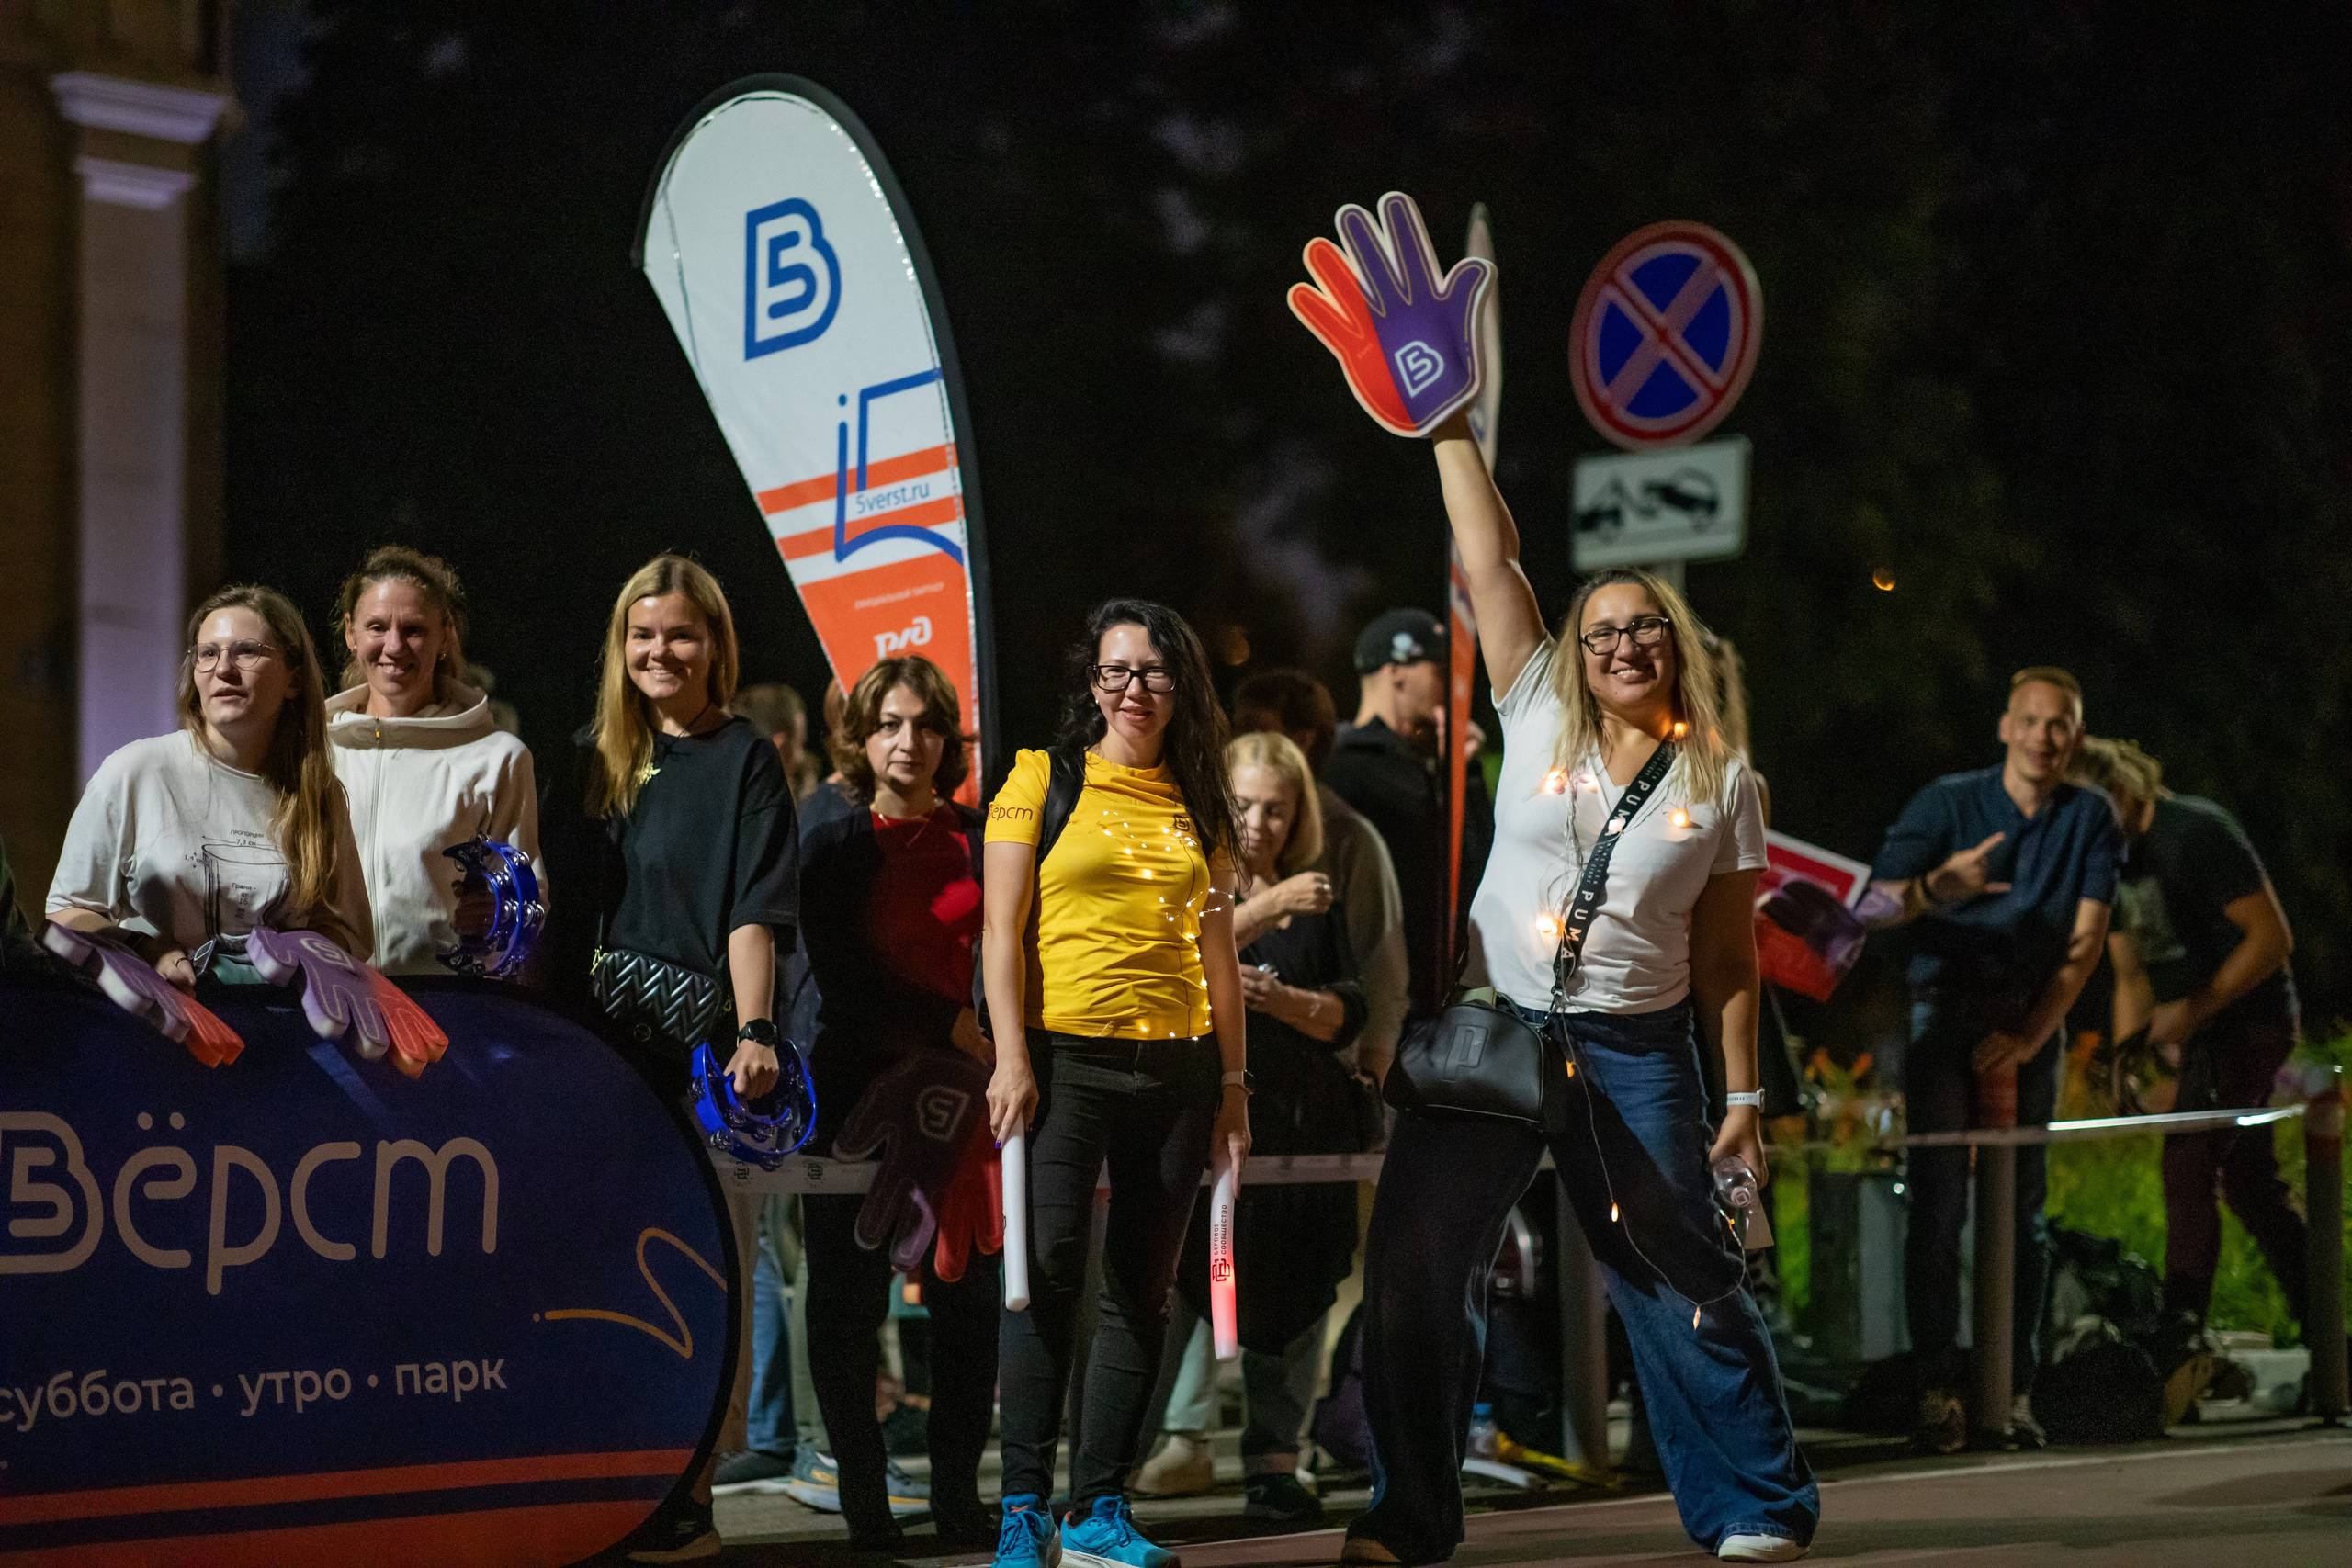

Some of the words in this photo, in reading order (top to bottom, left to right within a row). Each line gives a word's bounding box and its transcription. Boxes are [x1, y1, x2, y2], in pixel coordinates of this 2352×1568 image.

[856, 482, 930, 515] 5verst.ru
[988, 804, 1033, 821] ёрст
[1604, 780, 1651, 836] PUM
[236, 839, 247, 847] 7,3
[1562, 889, 1595, 959] PUMA
[238, 1368, 352, 1417] утро
[395, 1359, 507, 1403] парк
